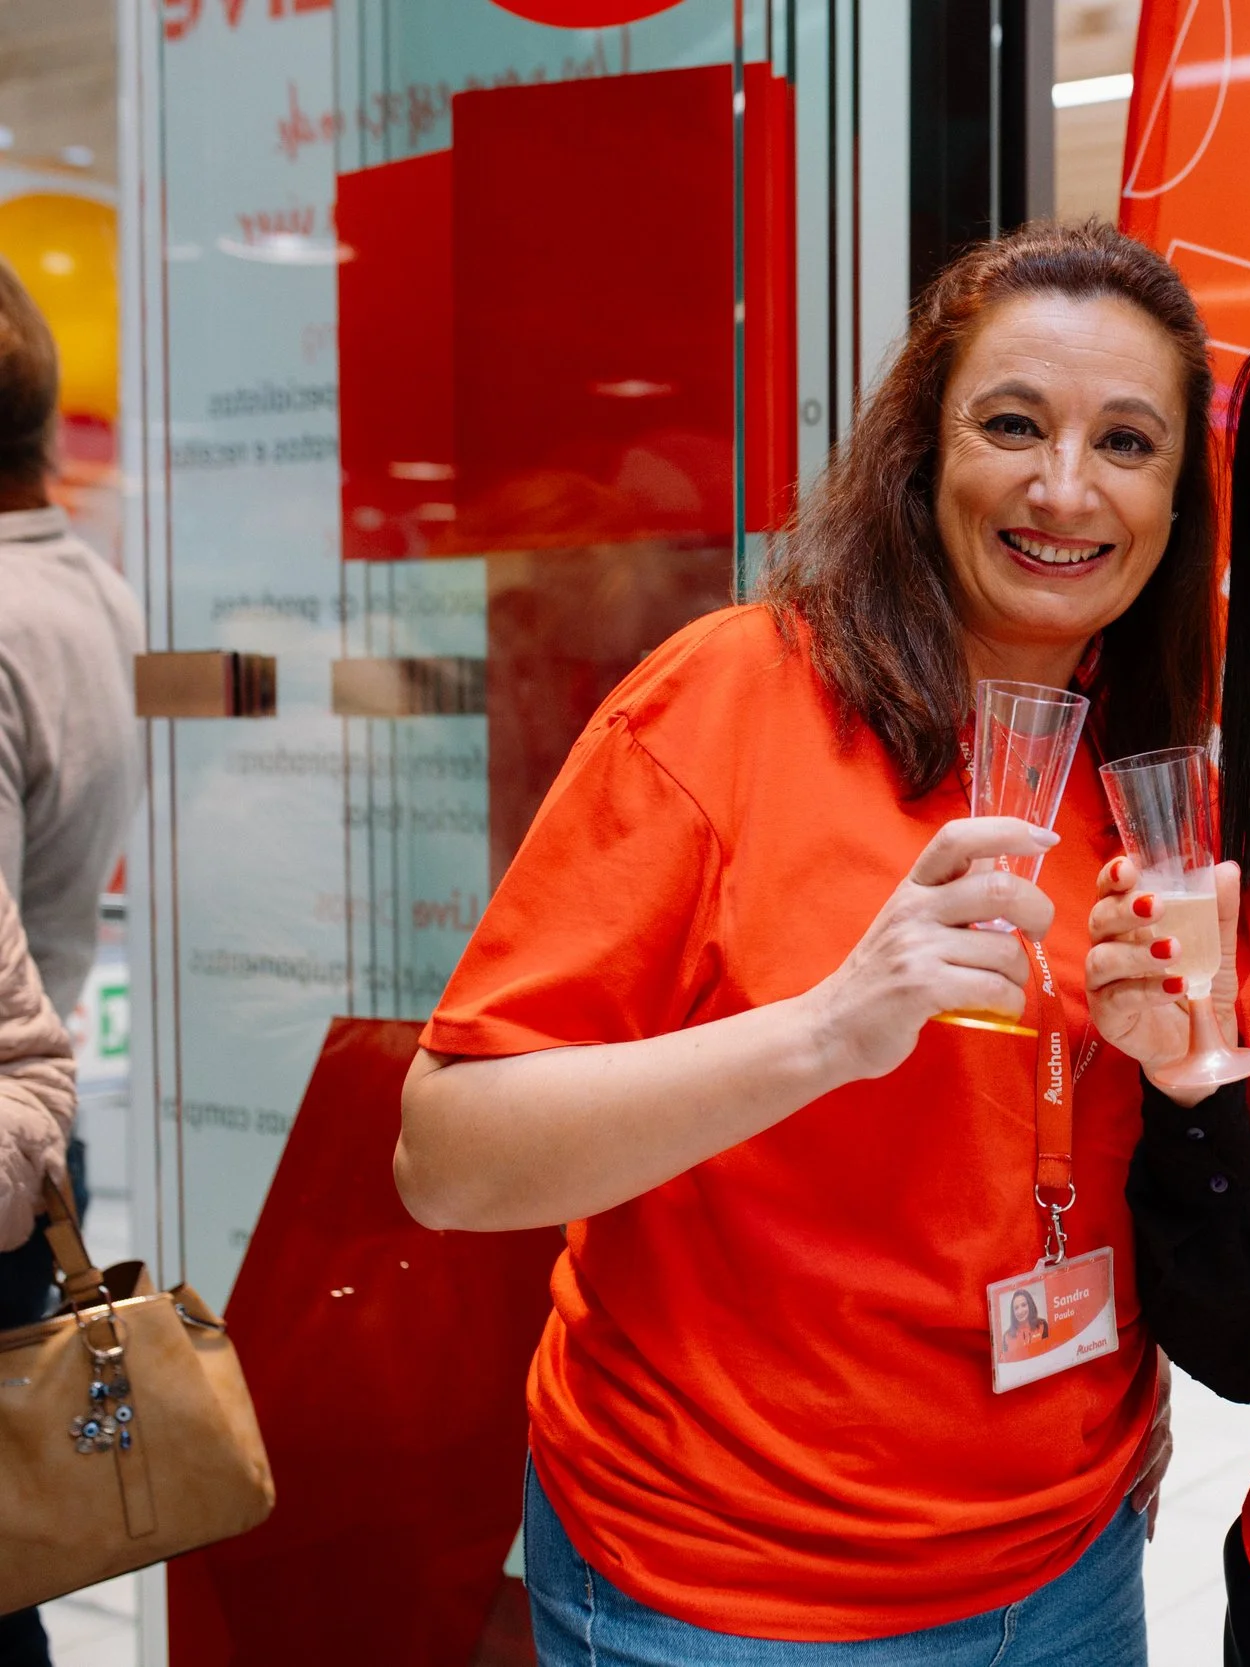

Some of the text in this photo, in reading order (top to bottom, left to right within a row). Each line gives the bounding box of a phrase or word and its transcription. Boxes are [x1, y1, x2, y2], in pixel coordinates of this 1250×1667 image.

[1033, 941, 1056, 998] Aucha
[1044, 1031, 1063, 1105] Auchan
[1073, 1040, 1098, 1084] chan
[1053, 1288, 1090, 1309] Sandra
[1076, 1337, 1108, 1356] Auchan
